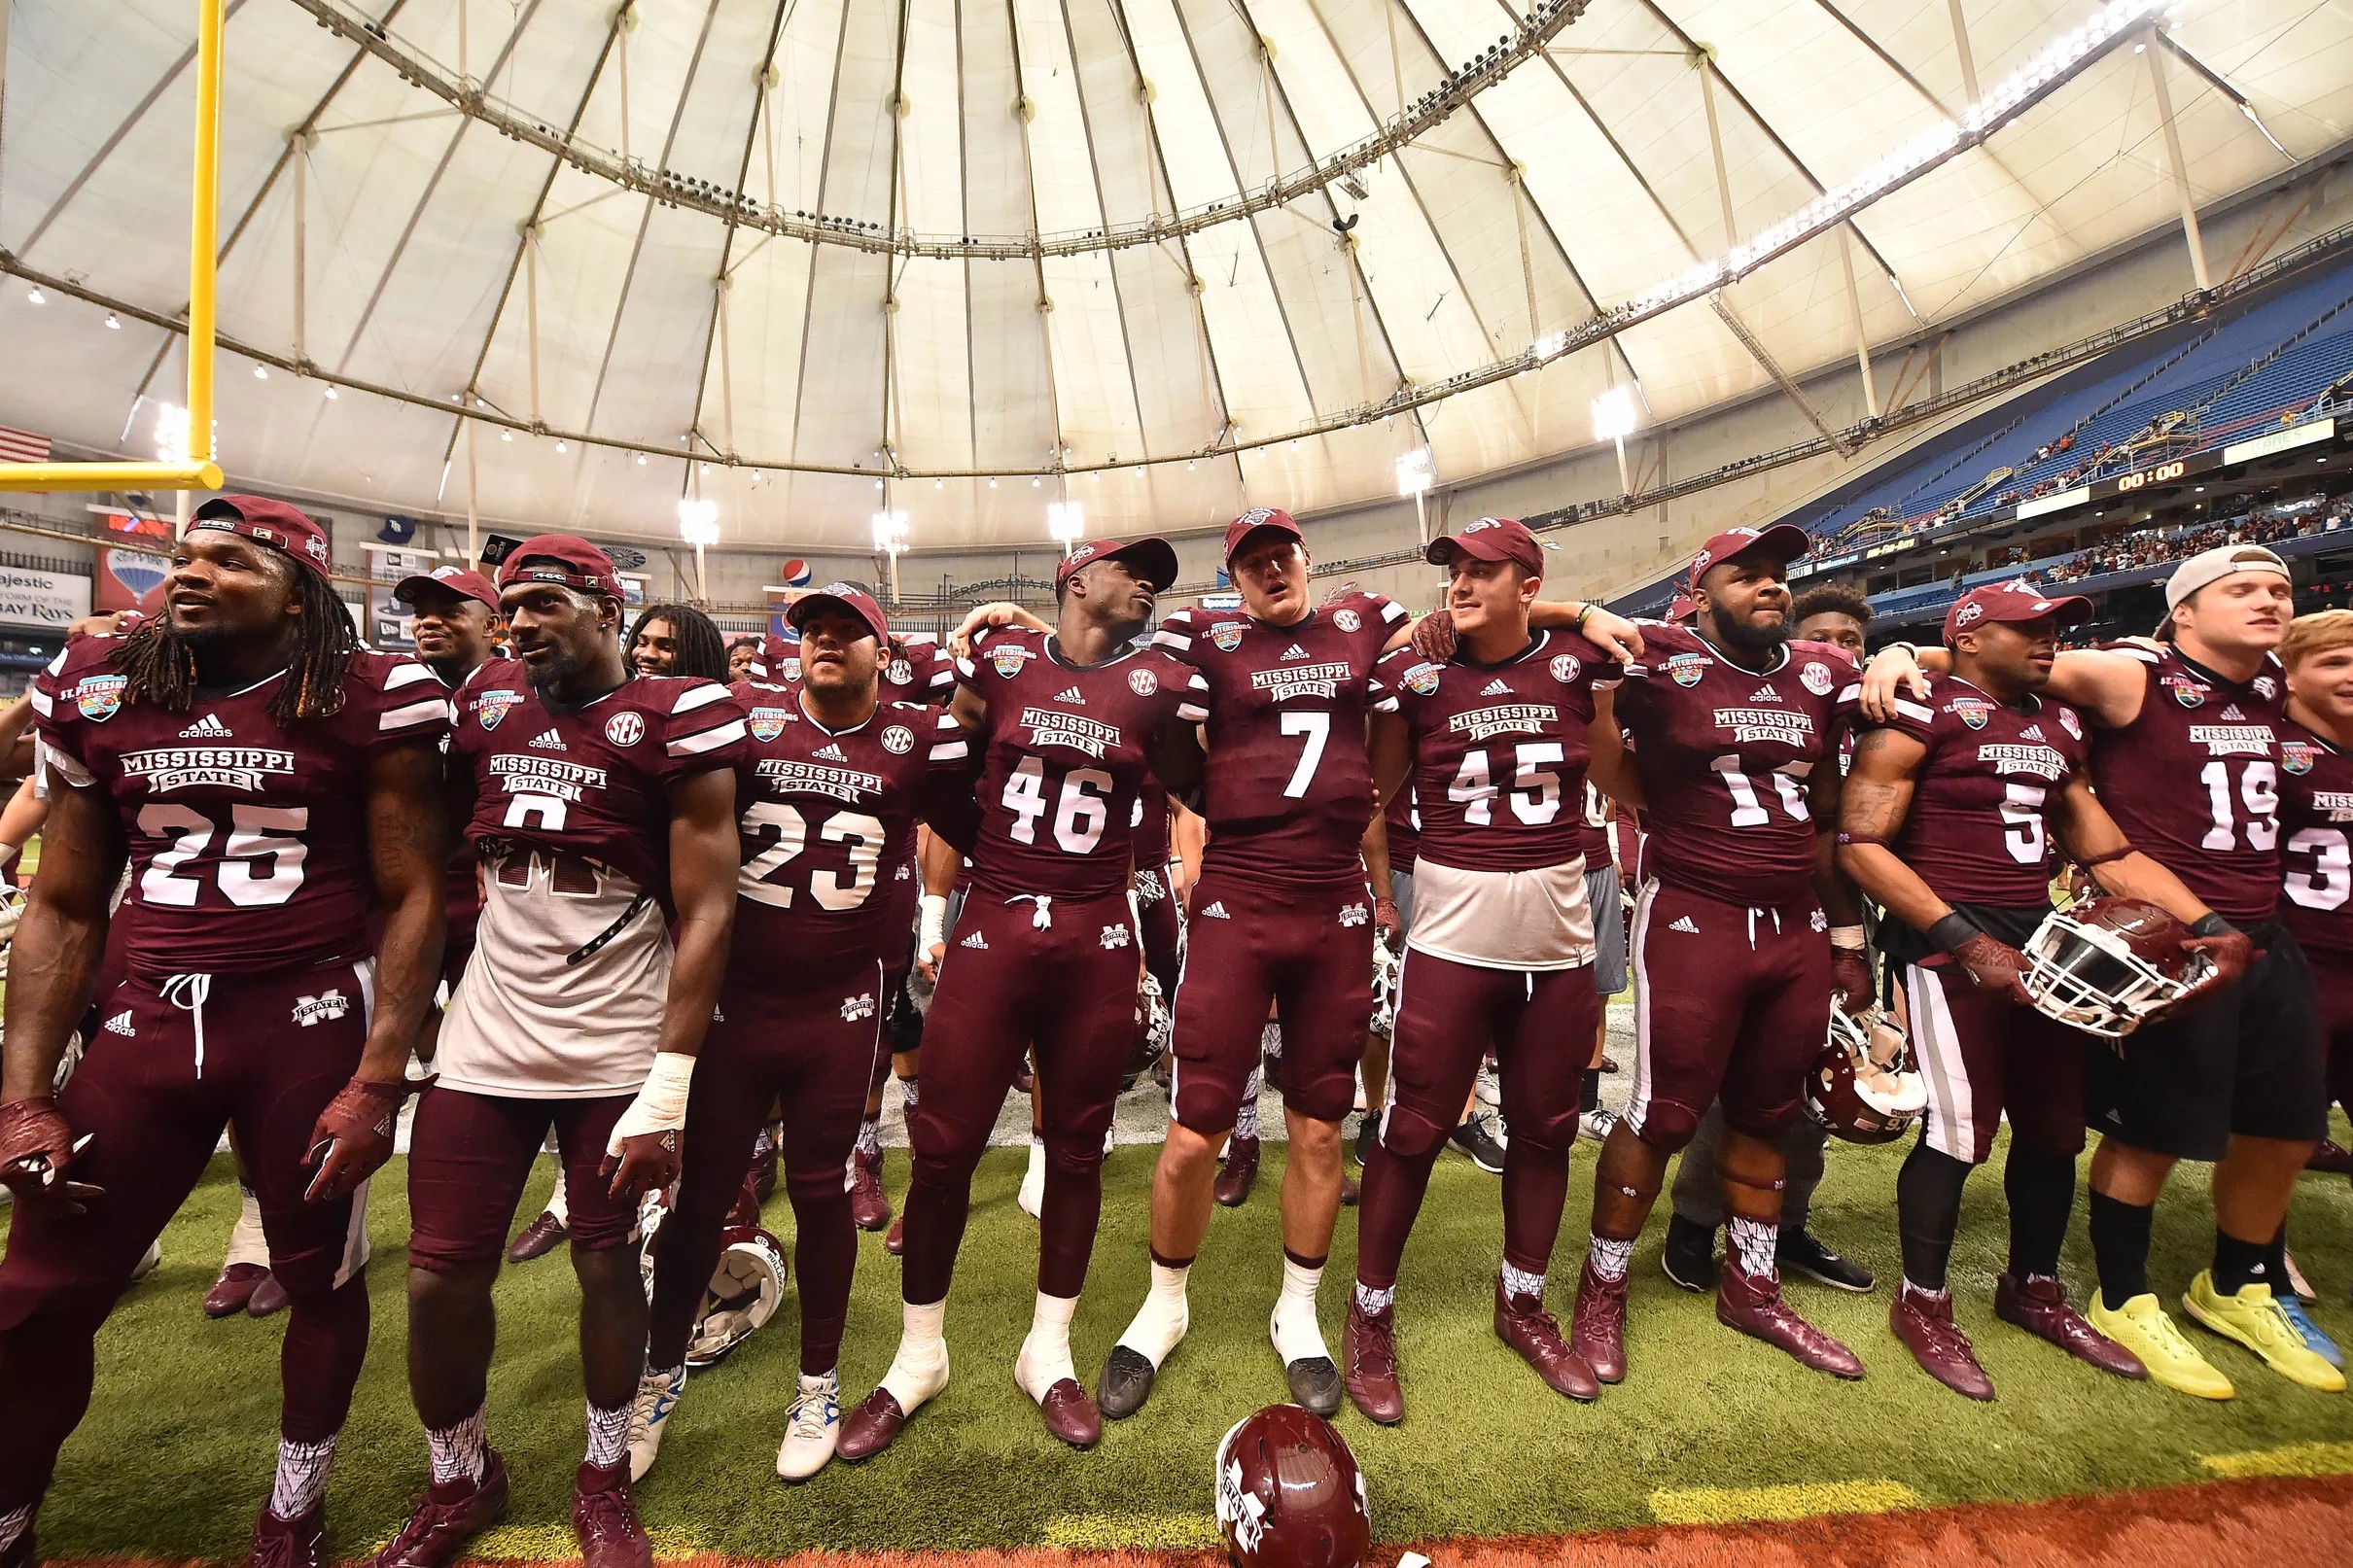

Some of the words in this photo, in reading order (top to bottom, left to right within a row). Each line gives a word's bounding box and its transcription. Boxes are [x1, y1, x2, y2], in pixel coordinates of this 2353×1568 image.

[2118, 462, 2185, 491] 00:00
[0, 574, 53, 590] ajestic
[1335, 610, 1359, 632] SEC
[1210, 623, 1252, 637] PETERSBURG
[992, 649, 1037, 660] PETERSBURG
[1279, 651, 1311, 661] adidas
[1552, 655, 1579, 680] SEC
[1668, 657, 1714, 670] PETERSBURG
[1130, 671, 1156, 696] SEC
[1250, 664, 1352, 687] MISSISSIPPI
[60, 688, 76, 701] ST.
[75, 681, 128, 697] PETERSB
[1282, 681, 1326, 696] STATE
[1480, 685, 1515, 696] adidas
[477, 694, 526, 709] PETERSBURG
[1053, 695, 1086, 705] adidas
[1749, 693, 1783, 703] adidas
[749, 712, 799, 722] PETERSBURG
[1449, 707, 1559, 731] MISSISSIPPI
[1713, 711, 1814, 731] MISSISSIPPI
[178, 727, 233, 739] adidas
[608, 713, 643, 745] SEC
[1022, 709, 1121, 745] MISSISSIPPI
[1481, 722, 1529, 734] STATE
[1748, 726, 1795, 743] STATE
[2190, 726, 2274, 741] MISSISSIPPI
[528, 738, 568, 751] adidas
[883, 726, 912, 753] SEC
[1042, 731, 1095, 753] STATE
[121, 750, 295, 774] MISSISSIPPI
[812, 749, 849, 763] adidas
[1281, 712, 1330, 799] 7
[489, 756, 607, 786] MISSISSIPPI
[755, 760, 883, 793] MISSISSIPPI
[2009, 760, 2054, 776] STATE
[166, 770, 242, 786] STATE
[515, 778, 568, 795] STATE
[1447, 742, 1564, 826] 45
[786, 780, 846, 797] STATE
[1001, 754, 1114, 854] 46
[2200, 760, 2280, 852] 19
[1998, 783, 2047, 864] 5
[136, 803, 308, 907] 25
[737, 801, 886, 911] 23
[1202, 909, 1231, 920] adidas
[961, 939, 989, 950] adidas
[302, 999, 338, 1015] STATE
[847, 1001, 870, 1013] STATE
[766, 1252, 784, 1295] BULLDOGS
[1223, 1479, 1253, 1534] STATE
